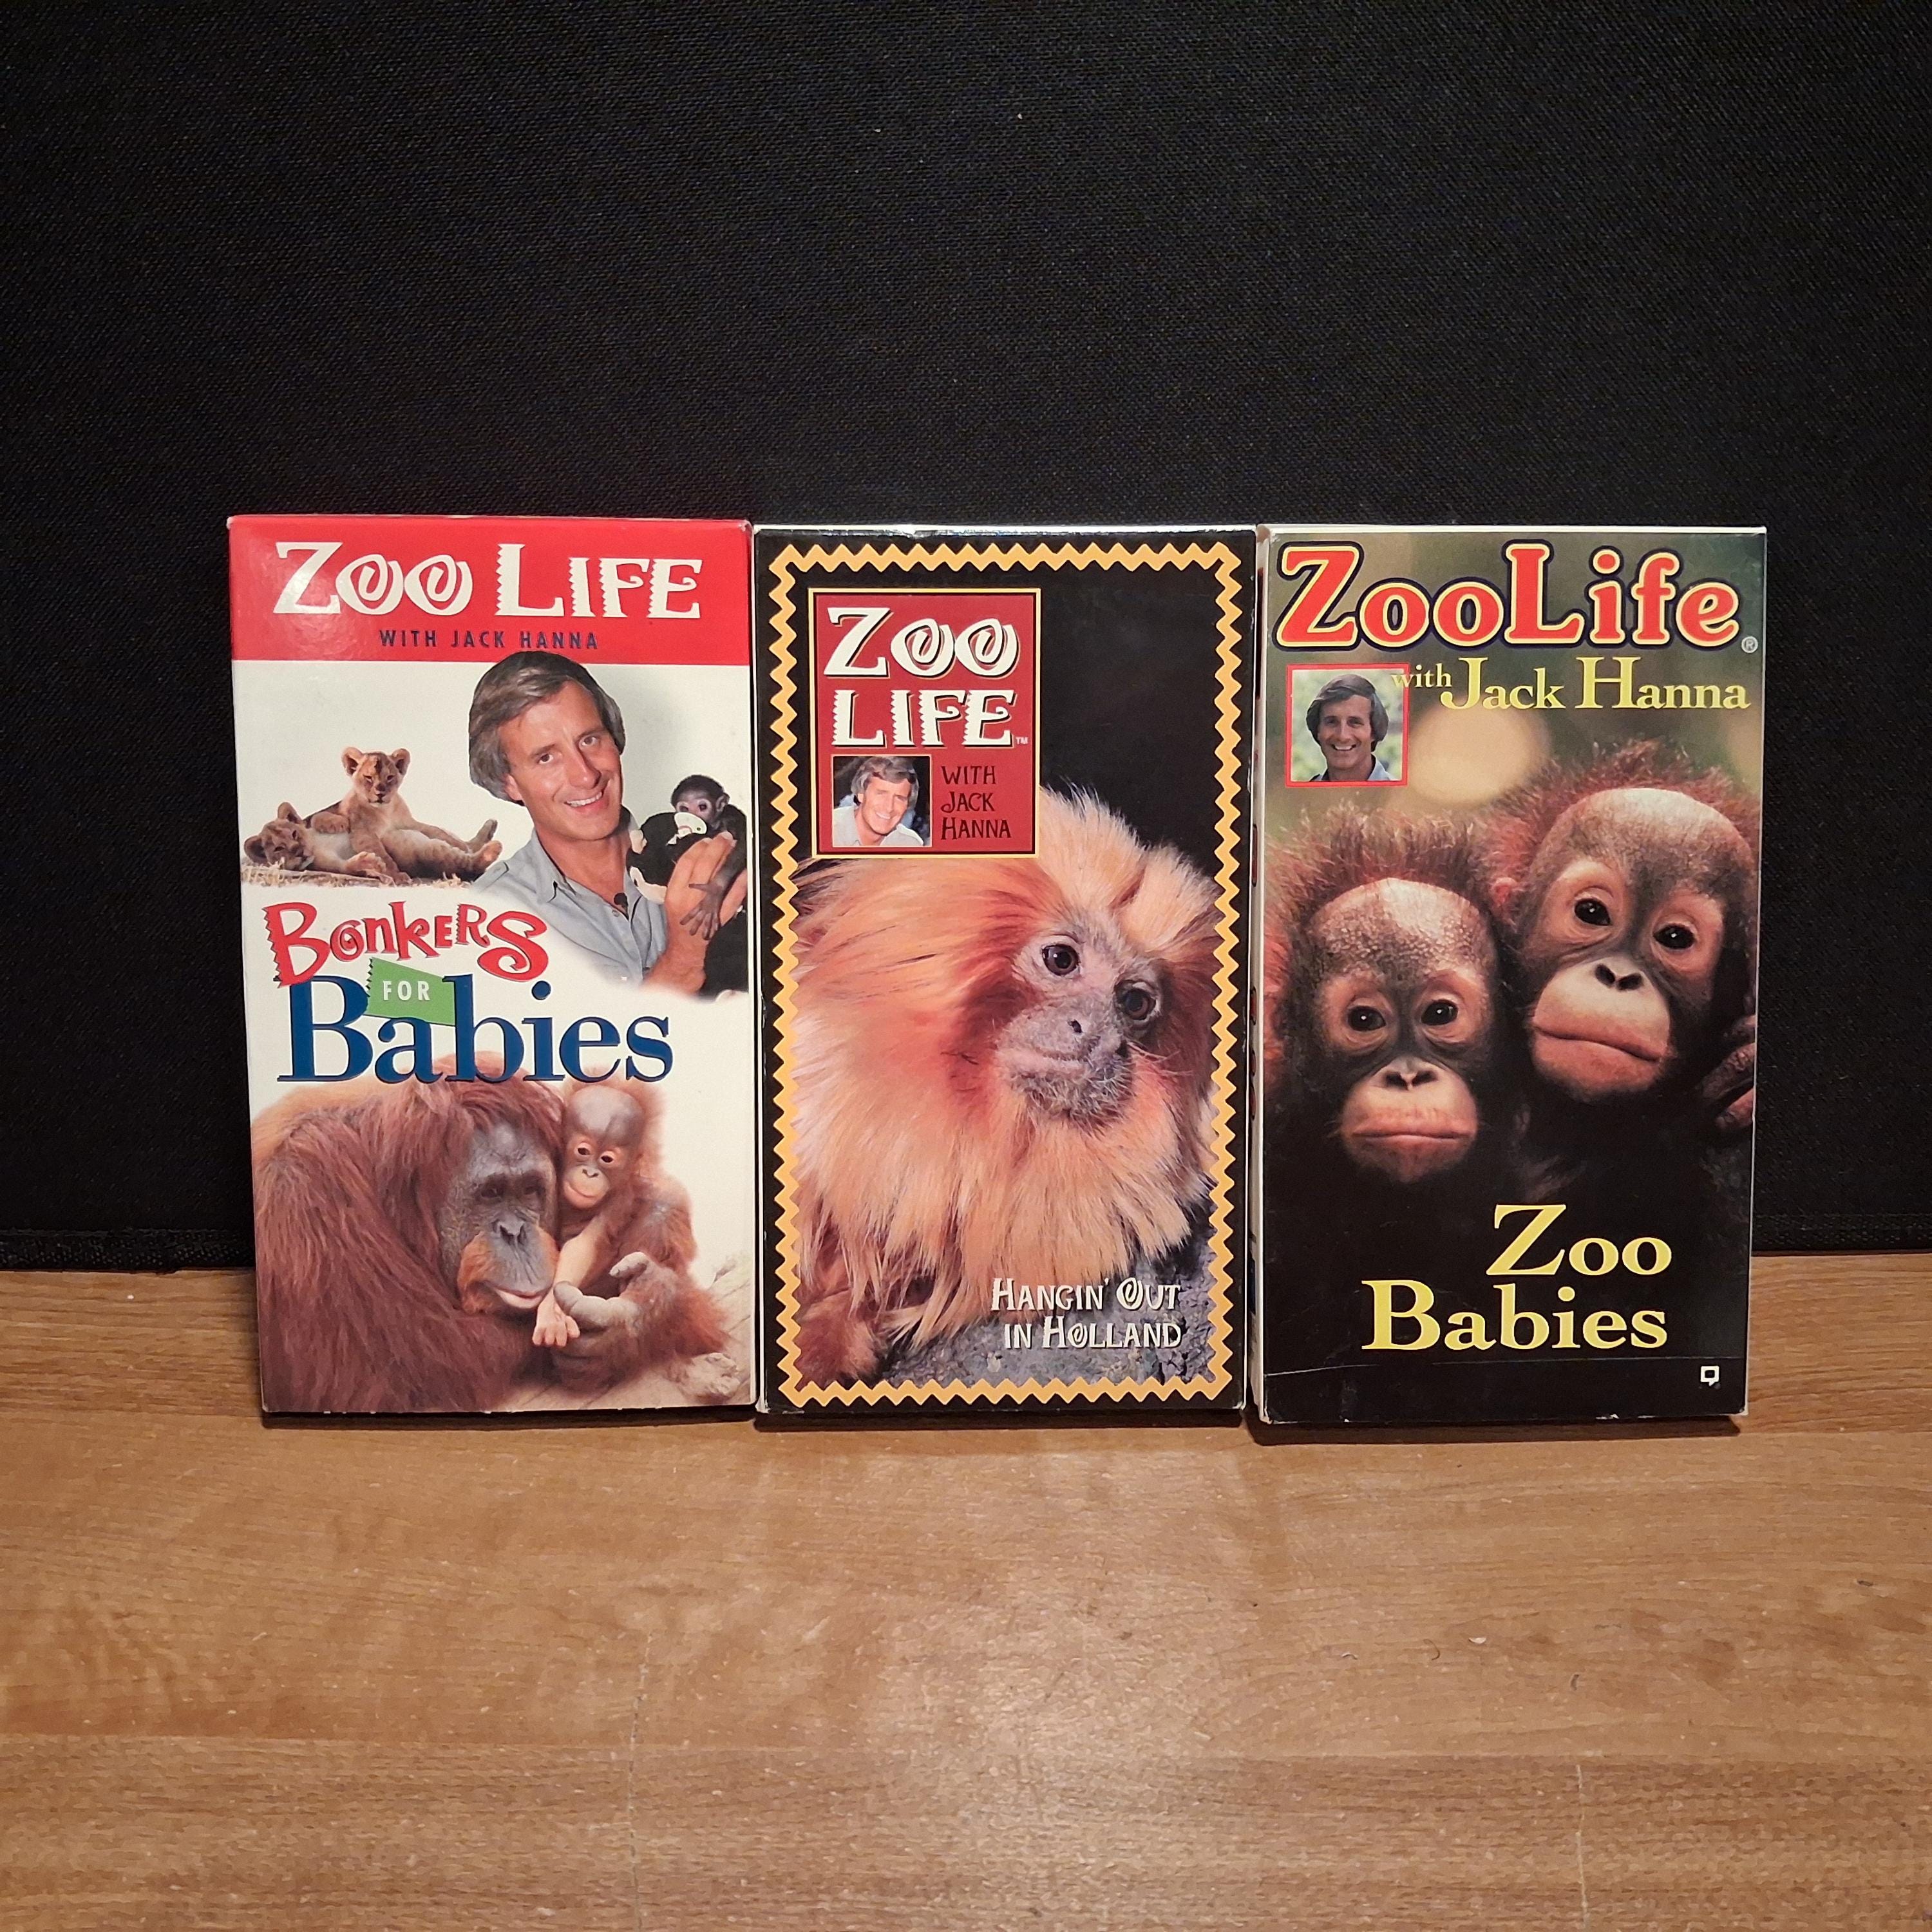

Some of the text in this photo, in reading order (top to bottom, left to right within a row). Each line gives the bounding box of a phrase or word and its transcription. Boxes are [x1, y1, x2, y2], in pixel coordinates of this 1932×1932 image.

[1272, 540, 1743, 651] ZooLife
[379, 629, 600, 650] WITH JACK HANNA
[1391, 656, 1750, 710] with Jack Hanna
[940, 766, 997, 785] WITH
[940, 792, 995, 813] JACK
[940, 819, 1012, 841] HANNA
[383, 980, 431, 1002] FOR
[276, 974, 674, 1083] Babies
[1486, 1204, 1672, 1275] Zoo
[1361, 1280, 1668, 1350] Babies
